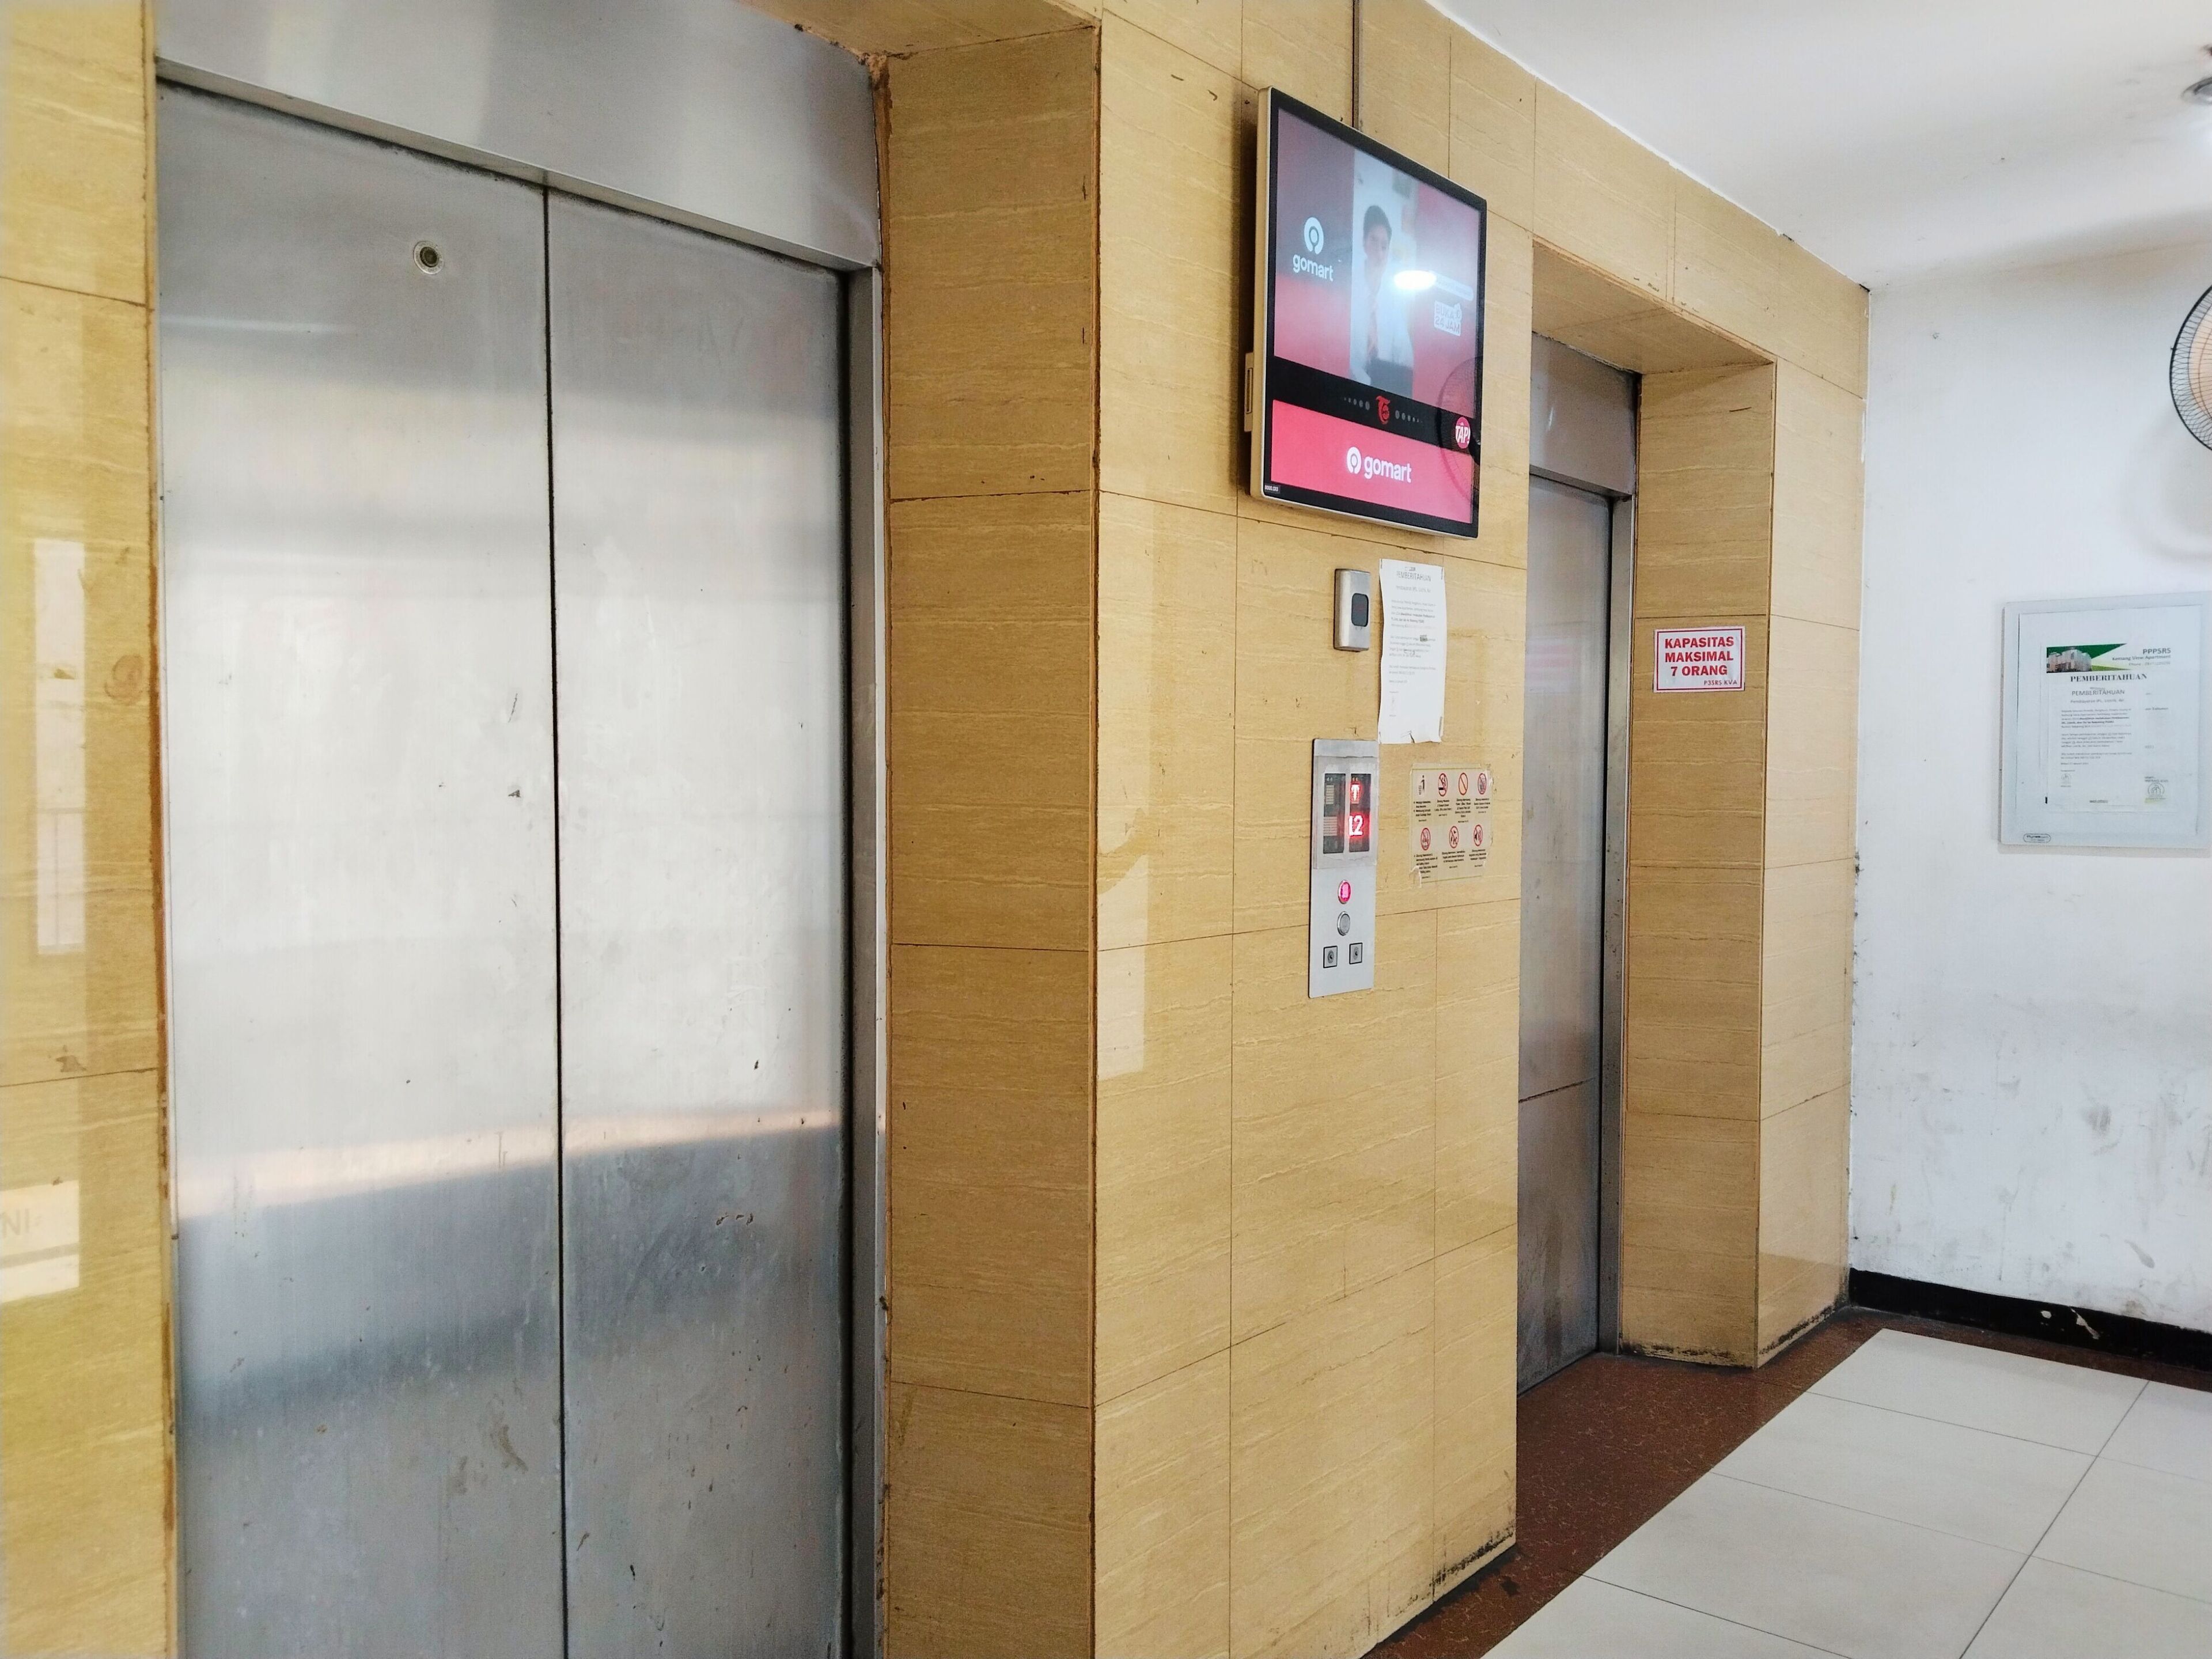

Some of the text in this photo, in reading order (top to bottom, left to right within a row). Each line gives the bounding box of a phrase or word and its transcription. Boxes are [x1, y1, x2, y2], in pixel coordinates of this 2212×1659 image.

[1293, 254, 1334, 282] gomart
[1364, 456, 1411, 483] gomart
[1665, 636, 1734, 649] KAPASITAS
[1665, 650, 1734, 662] MAKSIMAL
[1671, 665, 1728, 676] 7 ORANG
[2070, 673, 2147, 683] PEMBERITAHUAN
